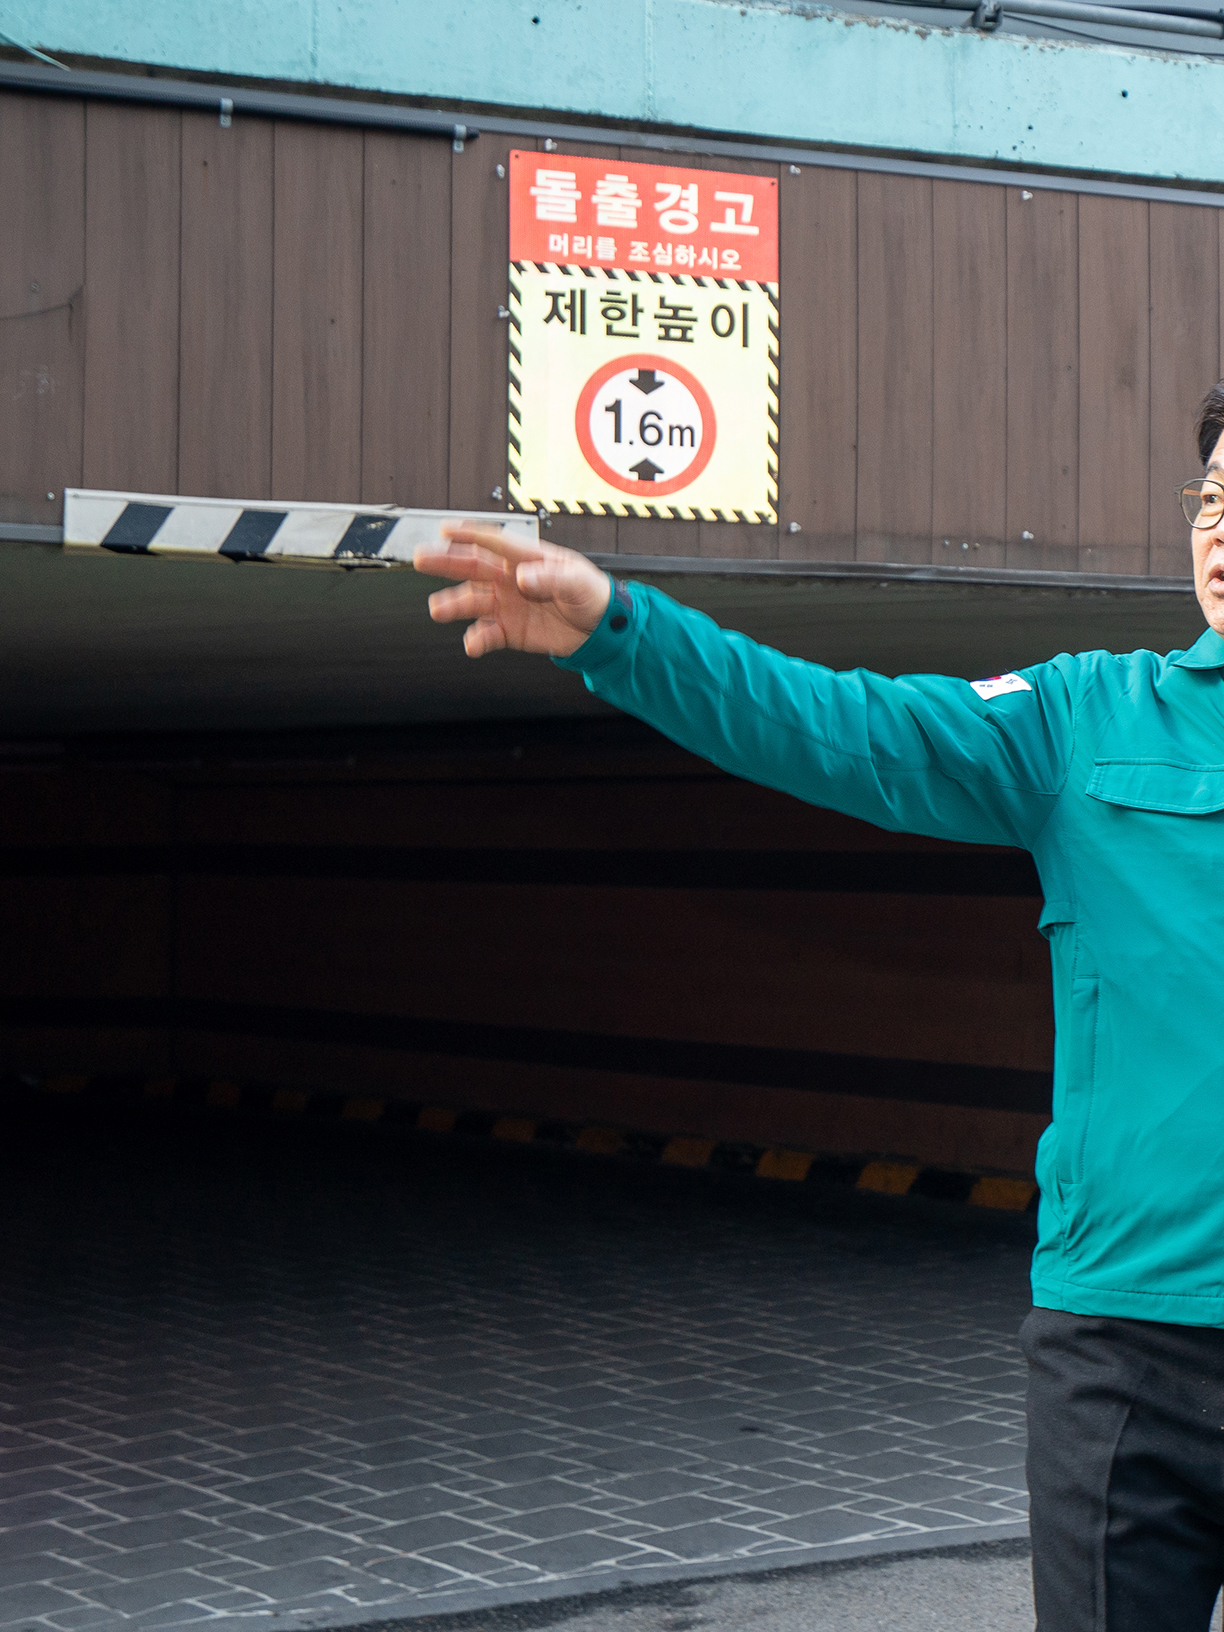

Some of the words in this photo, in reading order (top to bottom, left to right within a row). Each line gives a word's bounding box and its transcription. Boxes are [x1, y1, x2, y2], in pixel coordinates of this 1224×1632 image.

[530, 168, 760, 236] 돌출경고
[548, 233, 617, 261] 머리를
[628, 240, 742, 271] 조심하시오
[543, 287, 750, 348] 제한높이
[604, 398, 696, 448] 1.6m
